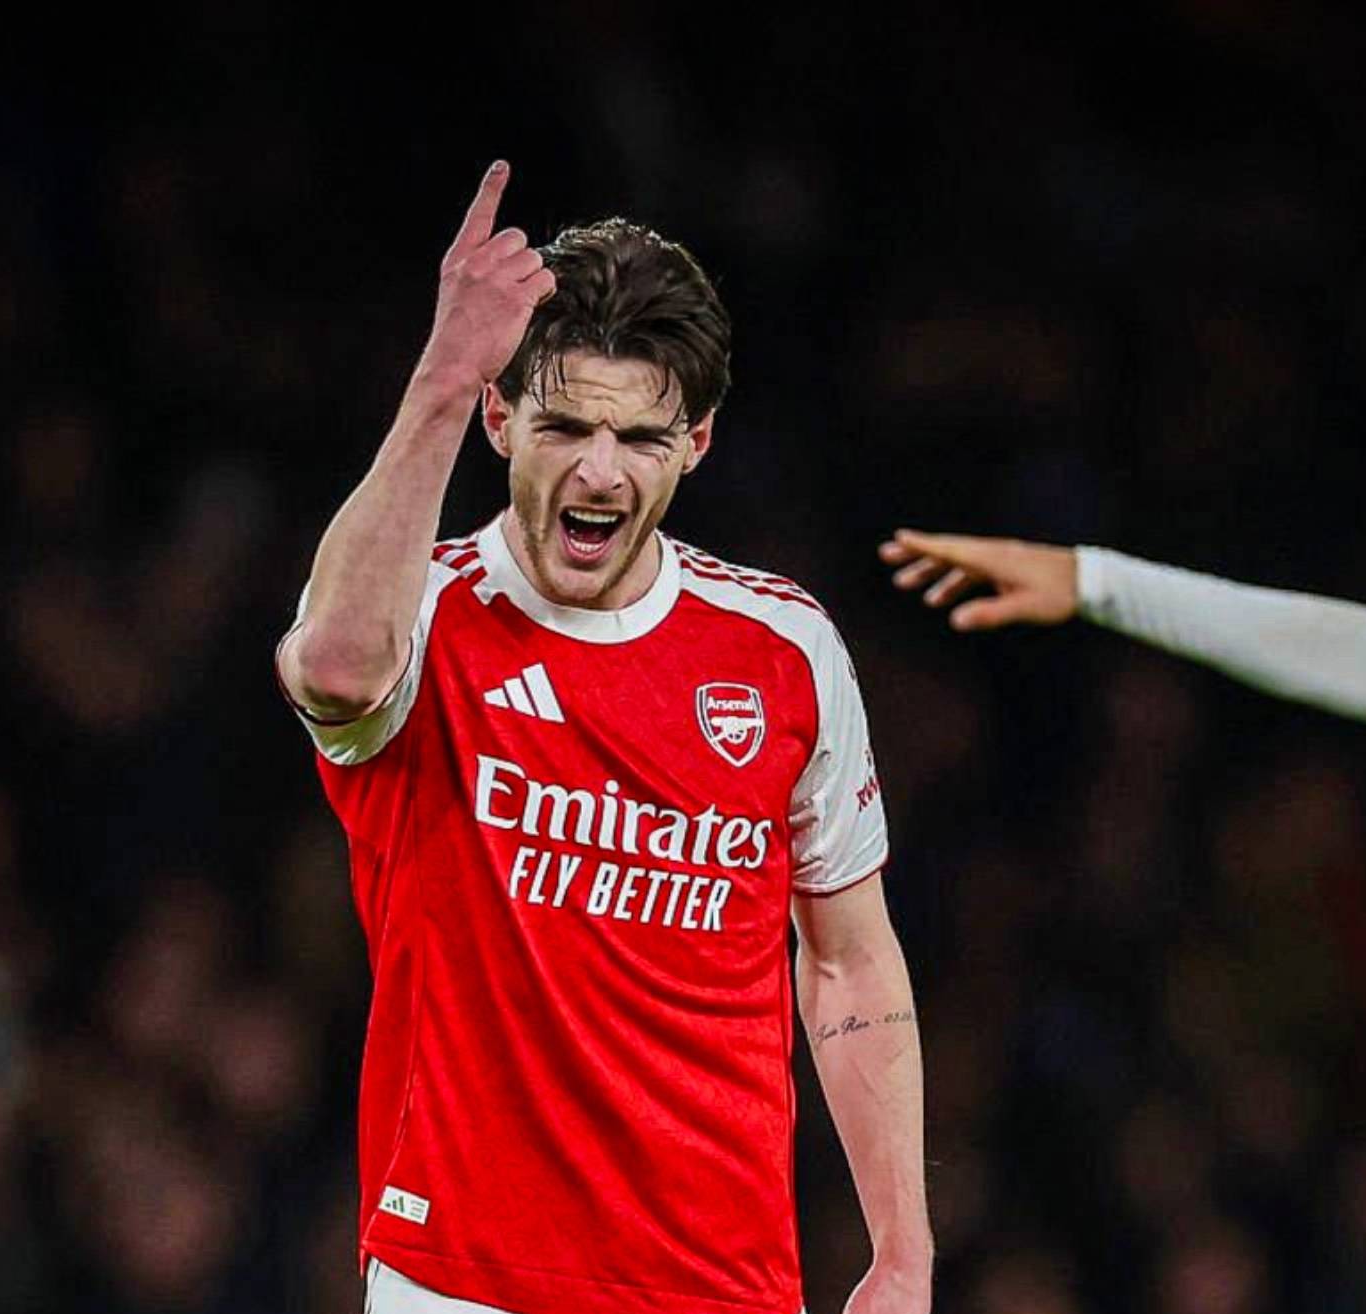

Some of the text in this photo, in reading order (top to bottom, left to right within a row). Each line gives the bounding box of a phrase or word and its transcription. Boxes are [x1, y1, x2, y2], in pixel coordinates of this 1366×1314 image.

[474, 753, 773, 870] Emirates
[508, 845, 732, 931] FLY BETTER
